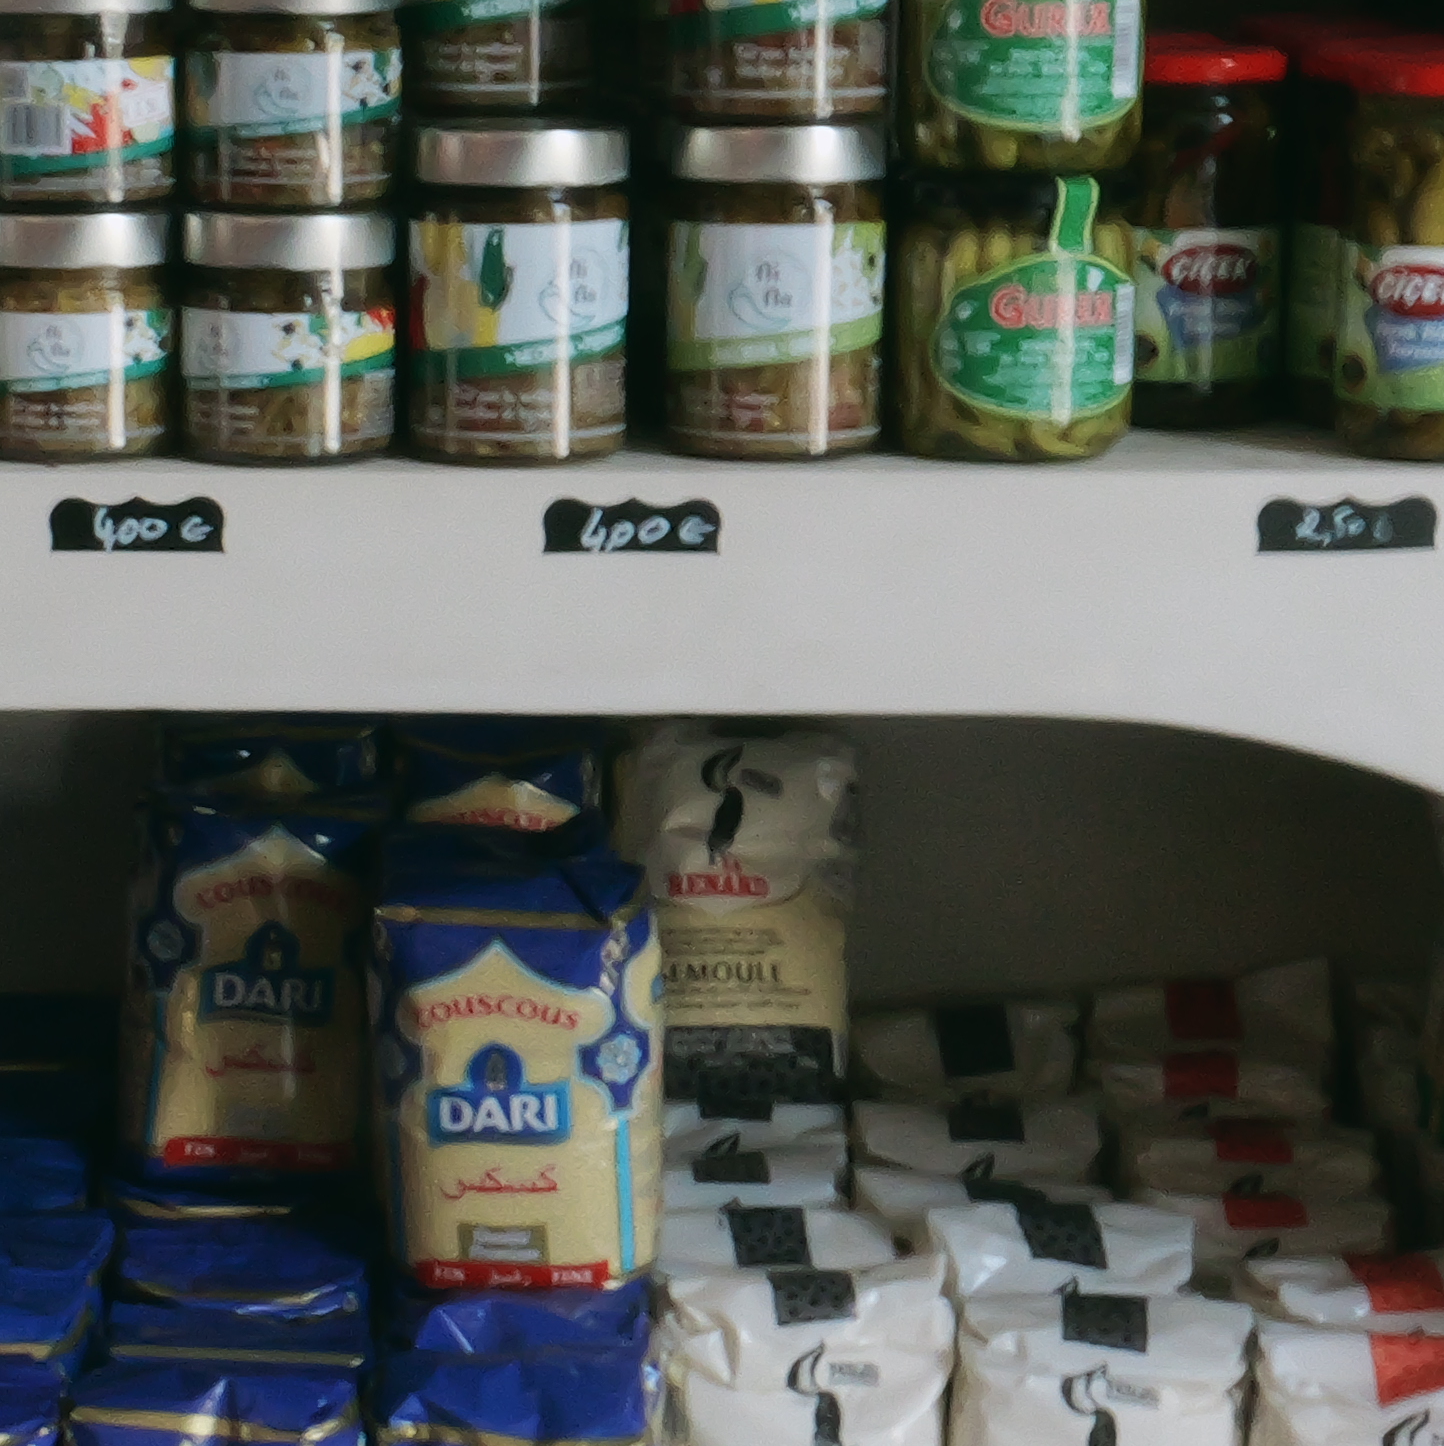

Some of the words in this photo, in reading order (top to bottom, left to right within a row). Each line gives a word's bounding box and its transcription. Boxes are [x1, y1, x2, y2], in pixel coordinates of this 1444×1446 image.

[213, 969, 324, 1011] DARI
[416, 995, 580, 1031] COUSCOUS
[438, 1094, 560, 1137] DARI
